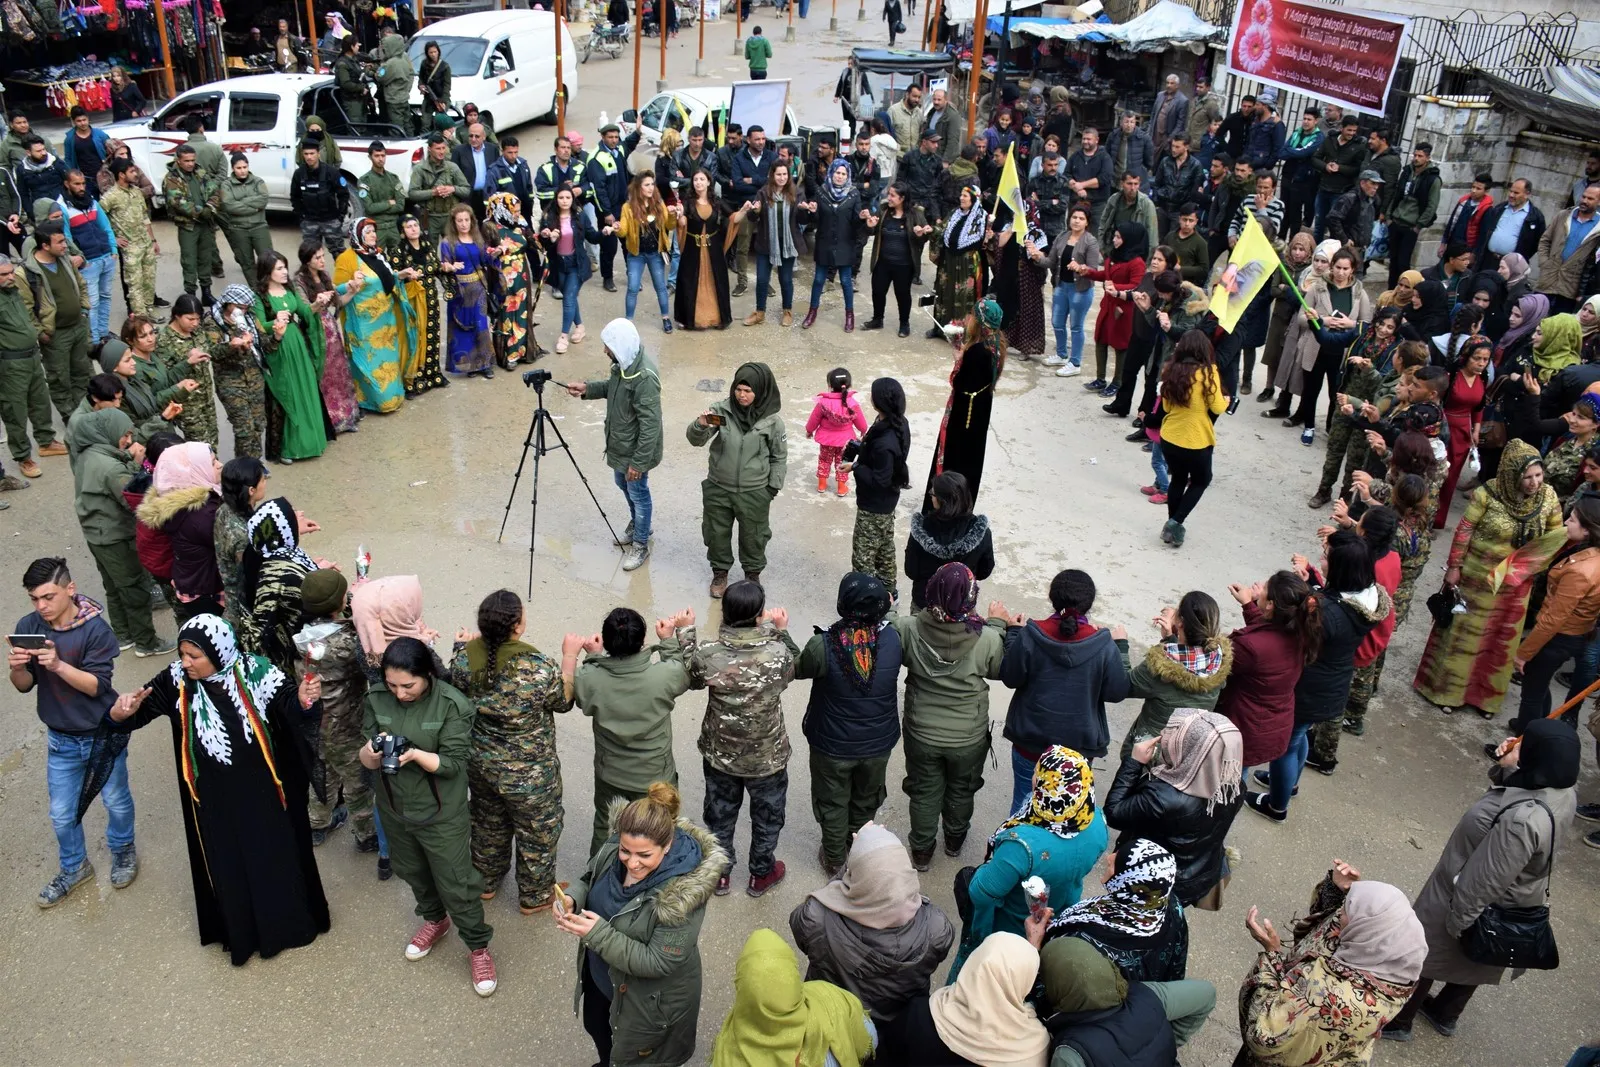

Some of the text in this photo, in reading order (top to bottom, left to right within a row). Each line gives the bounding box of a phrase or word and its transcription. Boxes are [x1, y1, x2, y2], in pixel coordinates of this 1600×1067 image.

[1359, 40, 1370, 53] be
[1310, 56, 1321, 67] يوم
[1331, 61, 1343, 73] يوم
